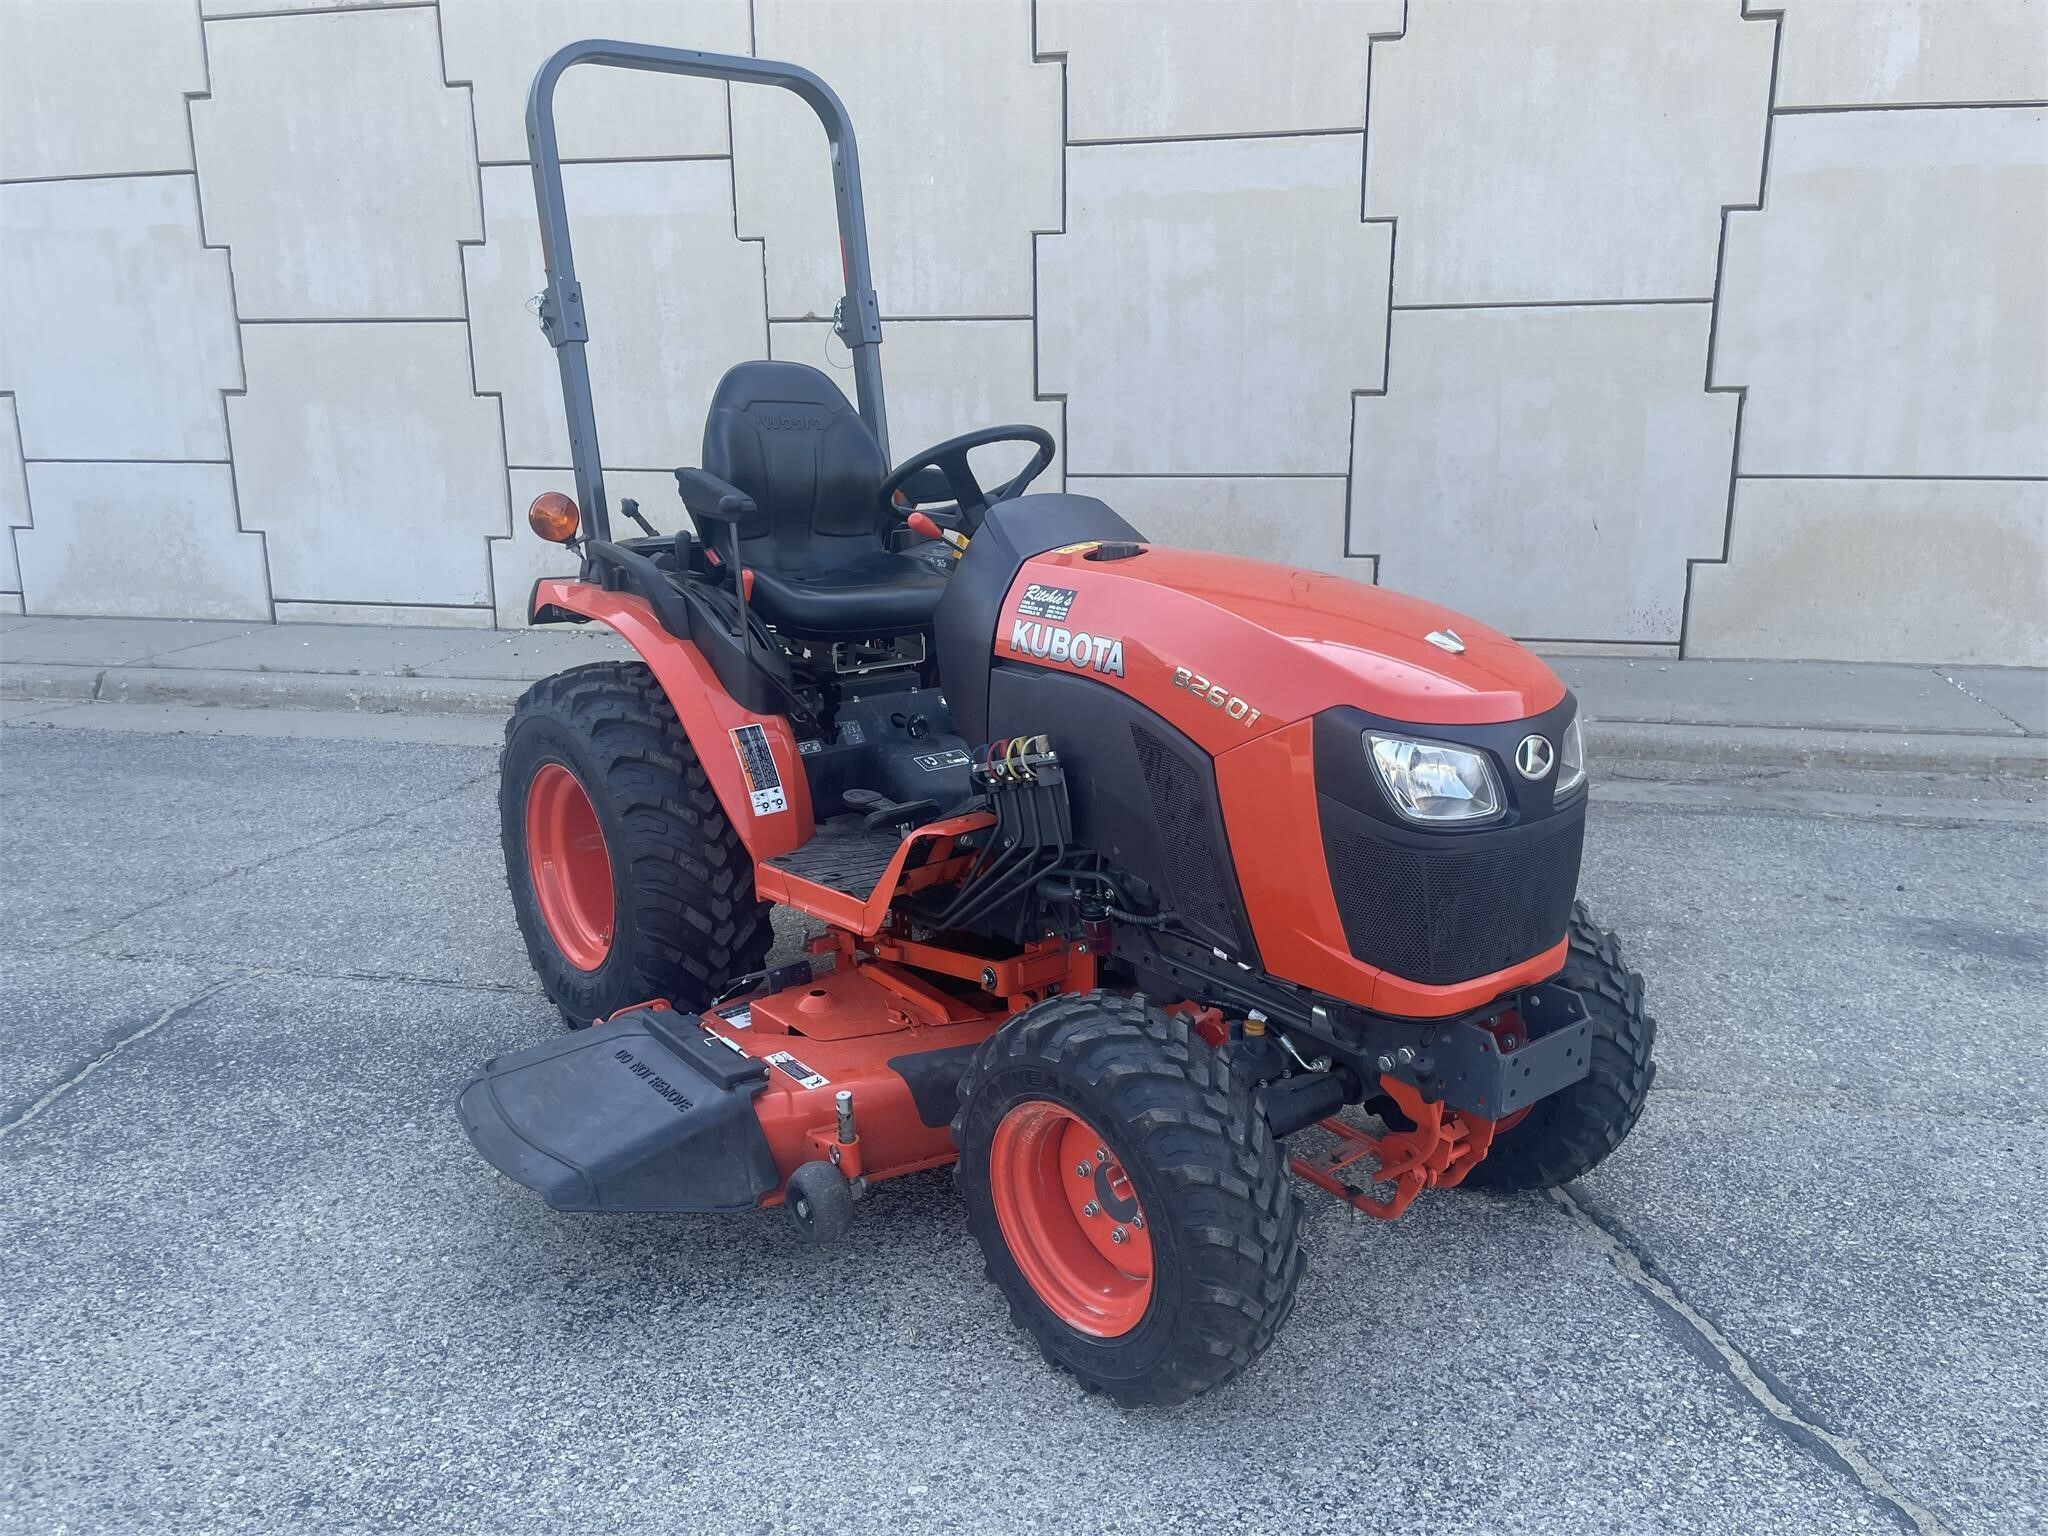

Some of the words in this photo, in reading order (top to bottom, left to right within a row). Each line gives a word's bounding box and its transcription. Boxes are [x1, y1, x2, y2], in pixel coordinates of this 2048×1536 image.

[1023, 585, 1073, 606] Ritchie's
[1011, 620, 1124, 678] KUBOTA
[1173, 666, 1262, 728] B2601
[614, 1049, 634, 1064] DO
[629, 1061, 656, 1080] NOT
[647, 1076, 694, 1113] REMOVE
